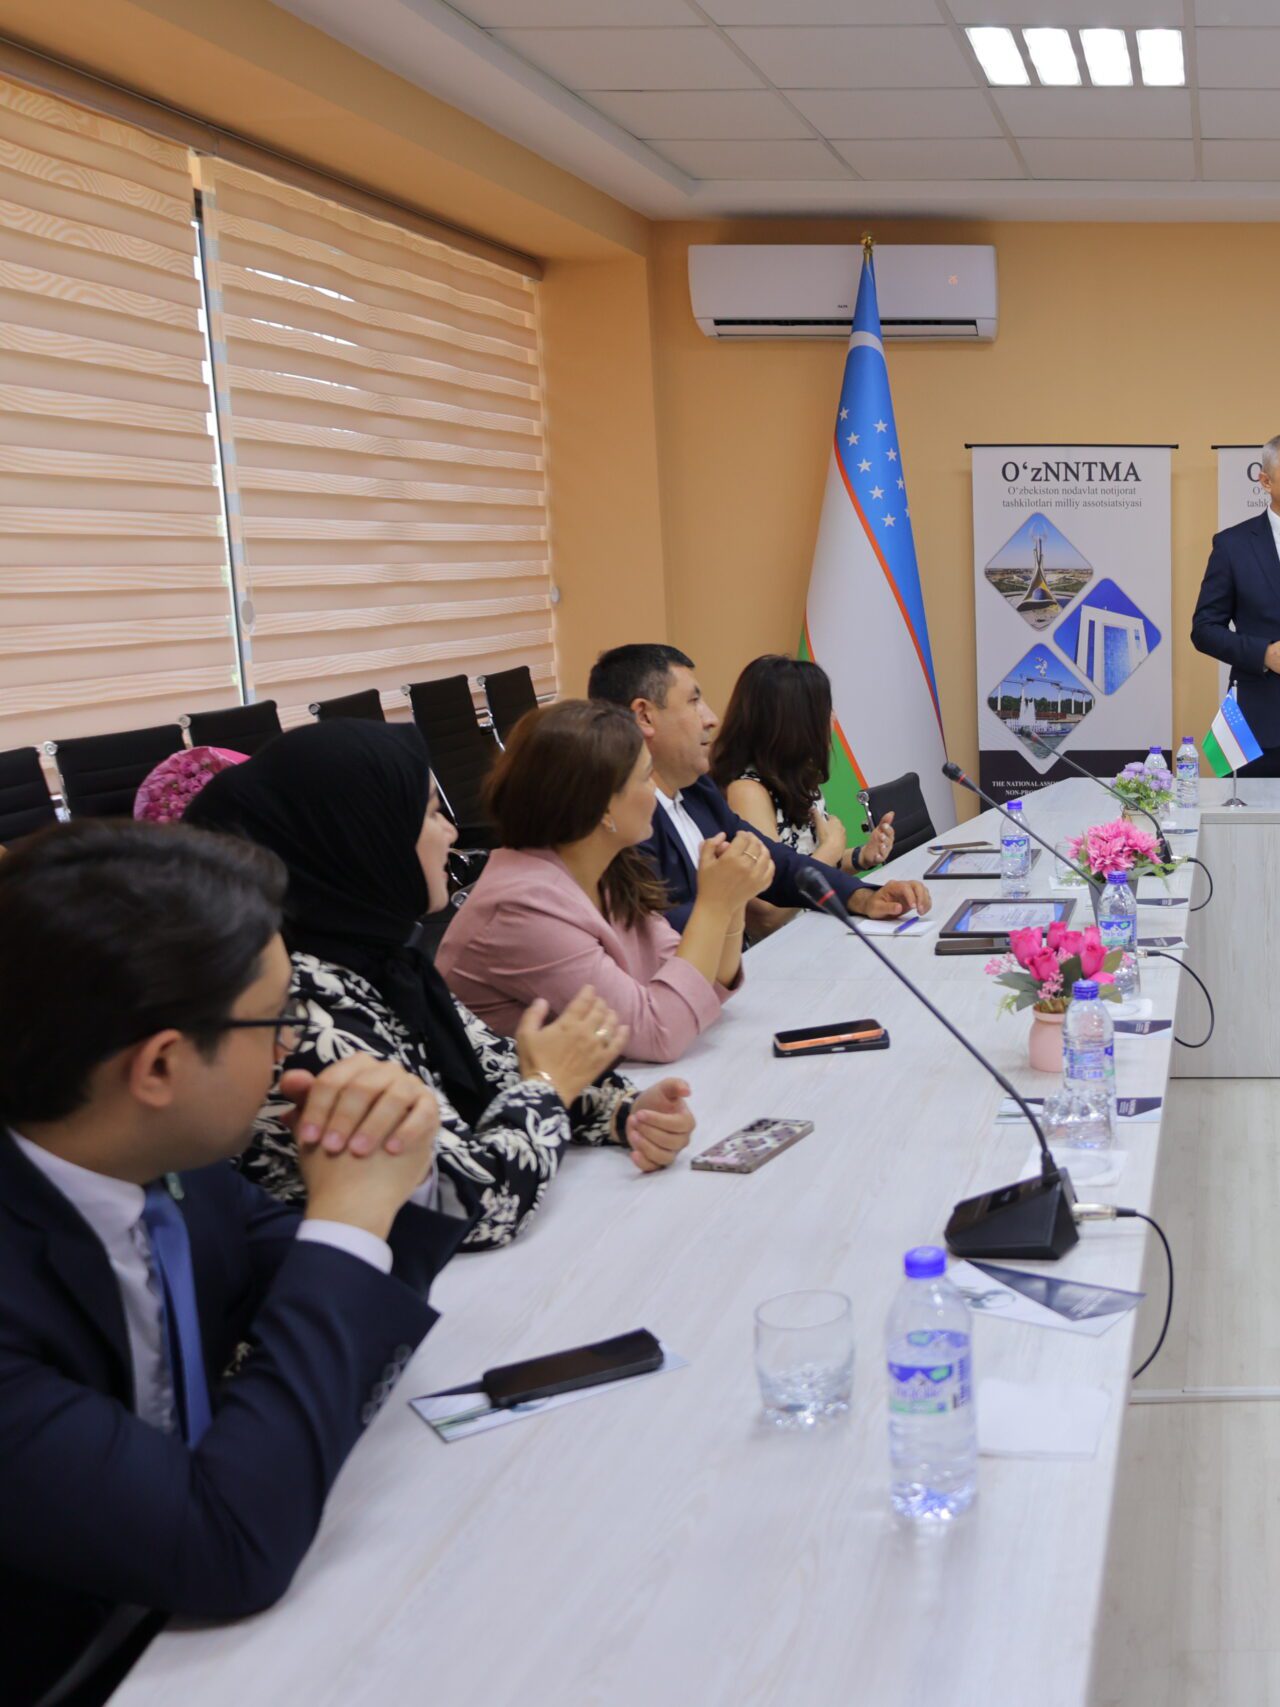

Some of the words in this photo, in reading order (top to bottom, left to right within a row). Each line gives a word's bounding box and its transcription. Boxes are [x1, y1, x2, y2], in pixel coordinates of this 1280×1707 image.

[1062, 486, 1098, 495] nodavlat
[1100, 486, 1136, 497] notijorat
[1002, 499, 1052, 508] tashkilotlari
[1055, 499, 1080, 510] milliy
[1082, 499, 1142, 510] assotsiatsiyasi
